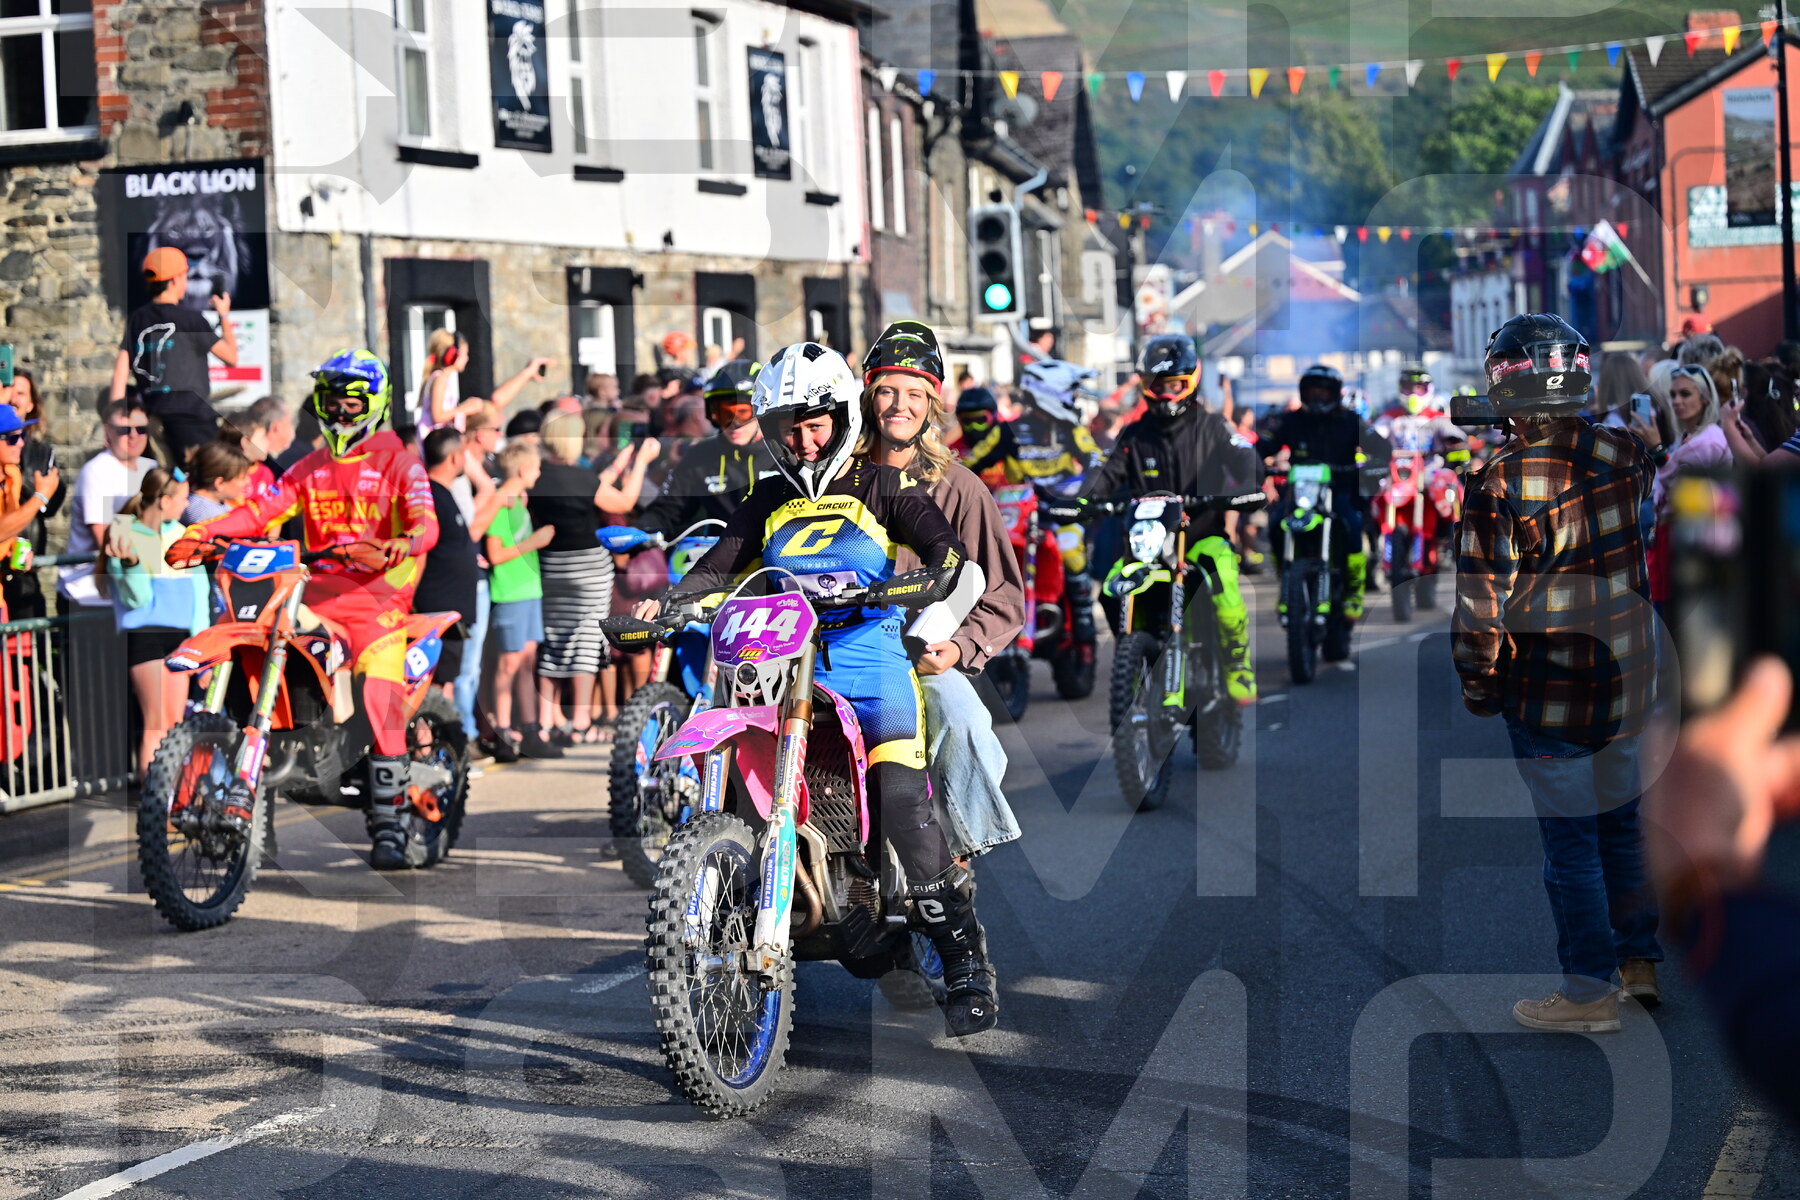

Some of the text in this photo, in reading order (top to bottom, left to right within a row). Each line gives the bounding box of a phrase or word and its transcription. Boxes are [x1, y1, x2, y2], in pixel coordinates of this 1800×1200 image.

[125, 168, 256, 198] BLACK LION
[816, 501, 855, 511] CIRCUIT
[236, 548, 277, 574] 8
[887, 584, 923, 596] CIRCUIT
[620, 630, 650, 641] CIRCUIT
[720, 608, 802, 646] 444
[406, 646, 430, 677] 8
[708, 762, 719, 808] MICHELIN
[781, 840, 791, 887] MOTOREX
[765, 859, 775, 908] MICHELIN
